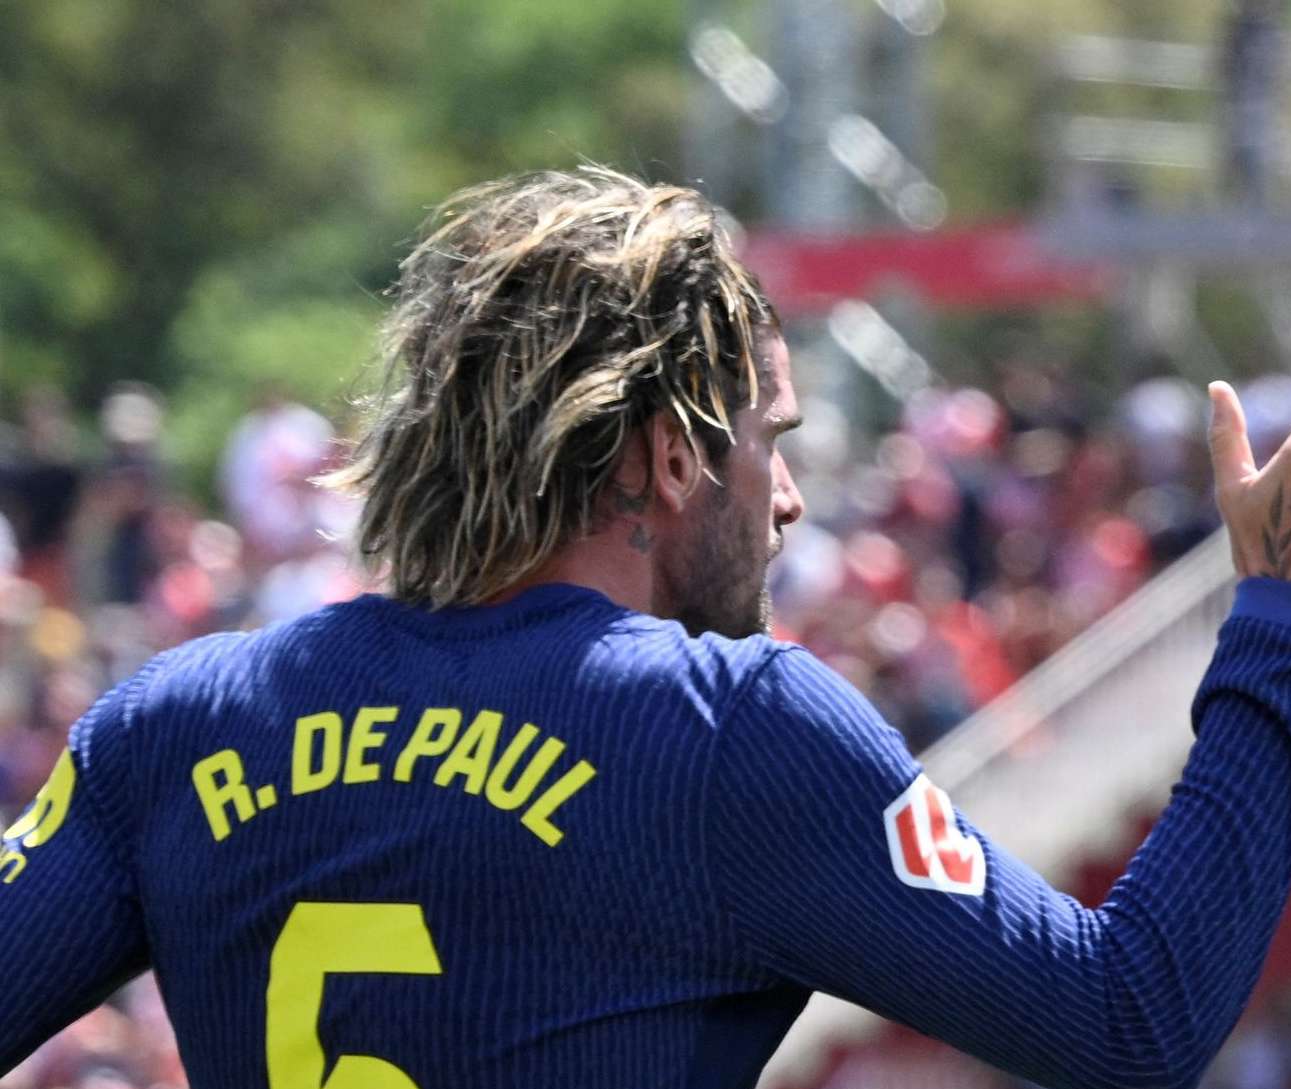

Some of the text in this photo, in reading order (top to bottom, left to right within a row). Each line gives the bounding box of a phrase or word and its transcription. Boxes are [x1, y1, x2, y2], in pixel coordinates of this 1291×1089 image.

[191, 706, 597, 848] R. DE PAUL
